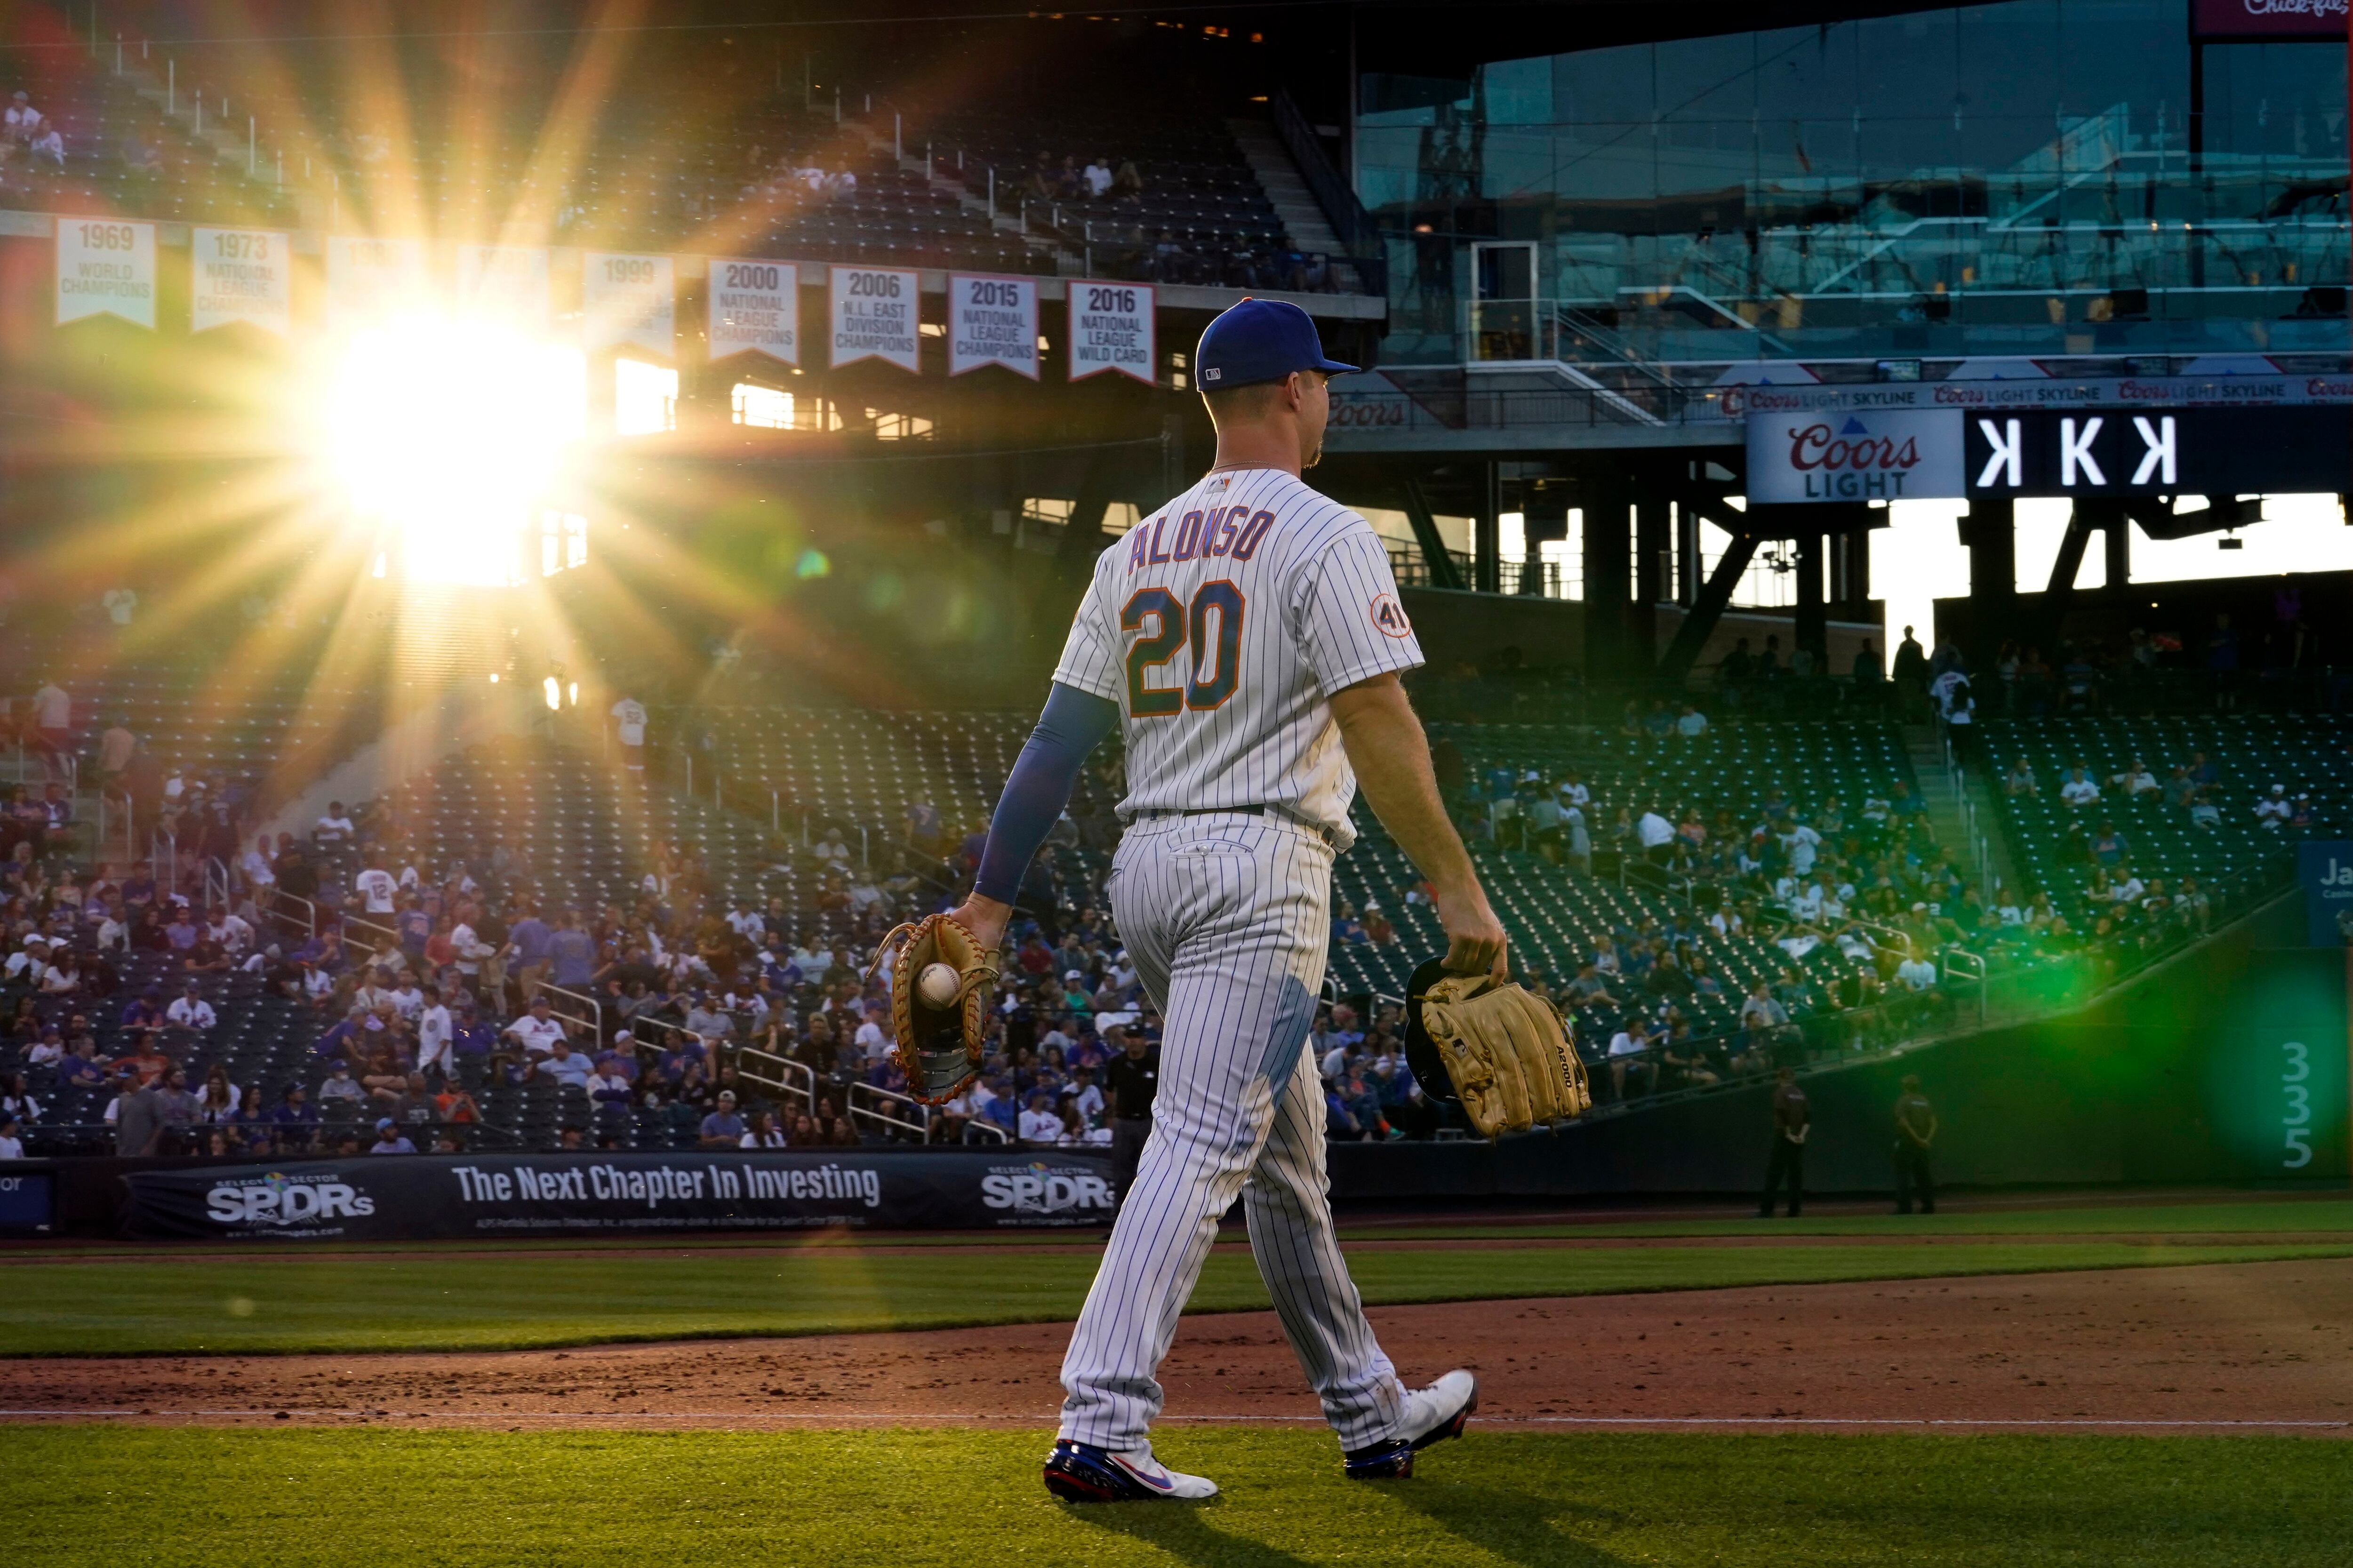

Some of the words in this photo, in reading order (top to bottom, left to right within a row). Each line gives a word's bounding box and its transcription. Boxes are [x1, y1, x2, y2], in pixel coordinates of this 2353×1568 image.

[78, 224, 134, 251] 1969
[214, 233, 268, 260] 1973
[78, 263, 133, 280] WORLD
[206, 263, 276, 281] NATIONAL
[603, 259, 655, 284] 1999
[726, 264, 778, 290] 2000
[62, 278, 150, 299] CHAMPIONS
[214, 280, 269, 297] LEAGUE
[848, 272, 901, 298] 2006
[970, 281, 1018, 307] 2015
[720, 293, 784, 311] NATIONAL
[843, 301, 871, 317] N.L.
[874, 303, 906, 318] EAST
[1088, 288, 1136, 313] 2016
[727, 310, 779, 328] LEAGUE
[846, 317, 904, 335] DIVISION
[963, 310, 1026, 327] NATIONAL
[1081, 315, 1143, 333] NATIONAL
[712, 327, 793, 345] CHAMPIONS
[835, 333, 915, 353] CHAMPIONS
[970, 326, 1019, 343] LEAGUE
[1088, 331, 1136, 347] LEAGUE
[956, 341, 1032, 360] CHAMPIONS
[1079, 346, 1111, 362] WILD
[1113, 348, 1147, 364] CARD
[1933, 384, 1984, 403] Coors
[1987, 389, 2033, 402] LIGHT
[2037, 387, 2101, 400] SKYLINE
[2119, 380, 2169, 399] Coors
[2172, 385, 2218, 399] LIGHT
[2221, 384, 2285, 397] SKYLINE
[1750, 391, 1800, 408] Coors
[1802, 393, 1847, 406] LIGHT
[1853, 392, 1916, 405] SKYLINE
[1788, 424, 1921, 471] Coors
[2061, 417, 2107, 486] K
[1805, 472, 1907, 497] LIGHT
[1128, 505, 1275, 575] ALONSO
[1379, 602, 1406, 630] 41
[1120, 579, 1246, 718] 20
[1556, 1045, 1572, 1088] A2000
[216, 1178, 264, 1187] SELECT
[290, 1174, 339, 1183] SECTOR
[451, 1166, 512, 1201] The
[514, 1167, 588, 1201] Next
[592, 1164, 704, 1208] Chapter
[709, 1164, 740, 1200] In
[743, 1163, 880, 1208] Investing
